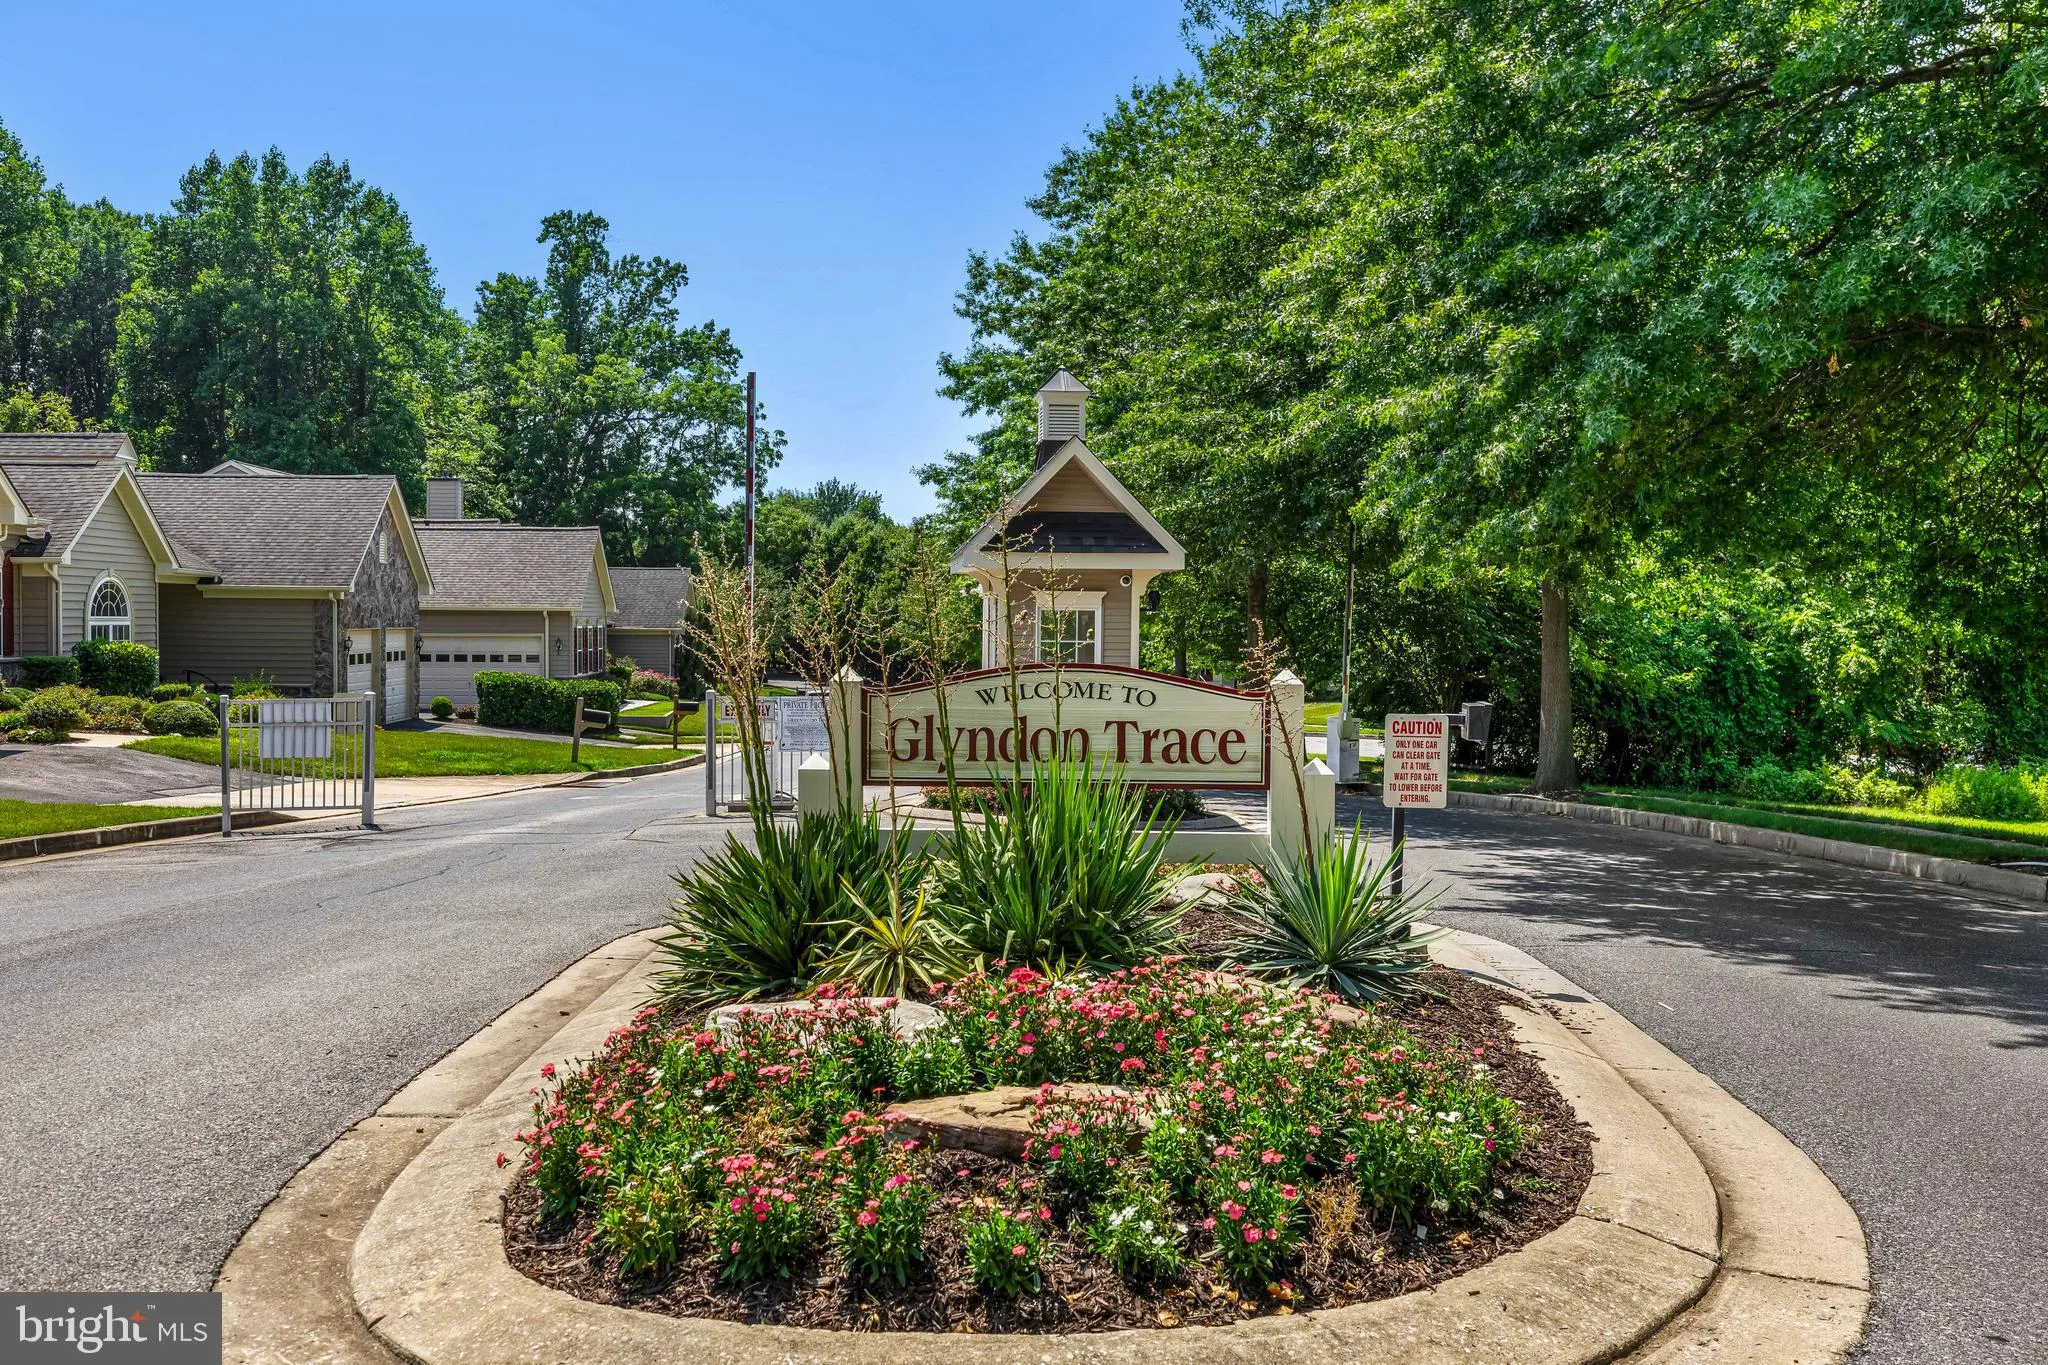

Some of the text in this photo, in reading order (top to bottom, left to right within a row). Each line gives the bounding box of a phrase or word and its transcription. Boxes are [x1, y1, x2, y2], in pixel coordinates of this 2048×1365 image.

[1122, 684, 1157, 707] TO
[783, 701, 809, 709] PRIVATE
[1392, 720, 1442, 735] CAUTION
[885, 714, 1247, 773] Glyndon Trace
[1395, 740, 1438, 749] ONLY ONE CAR
[1392, 751, 1441, 760] CAN CLEAR GATE
[1401, 762, 1432, 771] AT A TIME.
[1394, 772, 1438, 782] WAIT FOR GATE
[1389, 783, 1443, 793] TO LOWER BEFORE
[1400, 794, 1431, 803] ENTERING.
